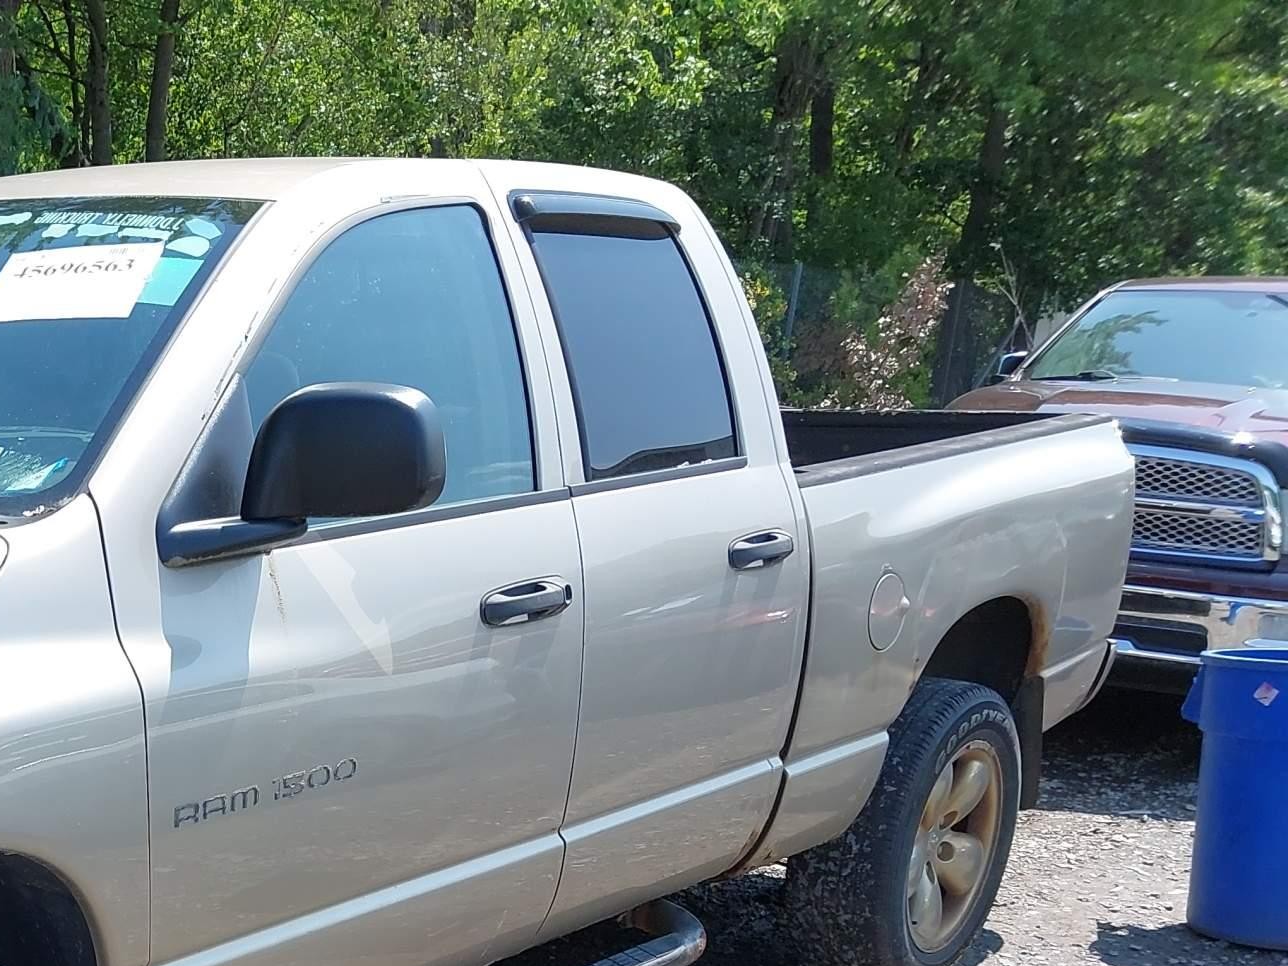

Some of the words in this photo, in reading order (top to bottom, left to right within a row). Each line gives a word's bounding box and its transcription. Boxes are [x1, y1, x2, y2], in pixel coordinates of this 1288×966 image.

[14, 258, 135, 278] 45696563
[173, 784, 260, 828] RAM
[271, 757, 358, 801] 1500
